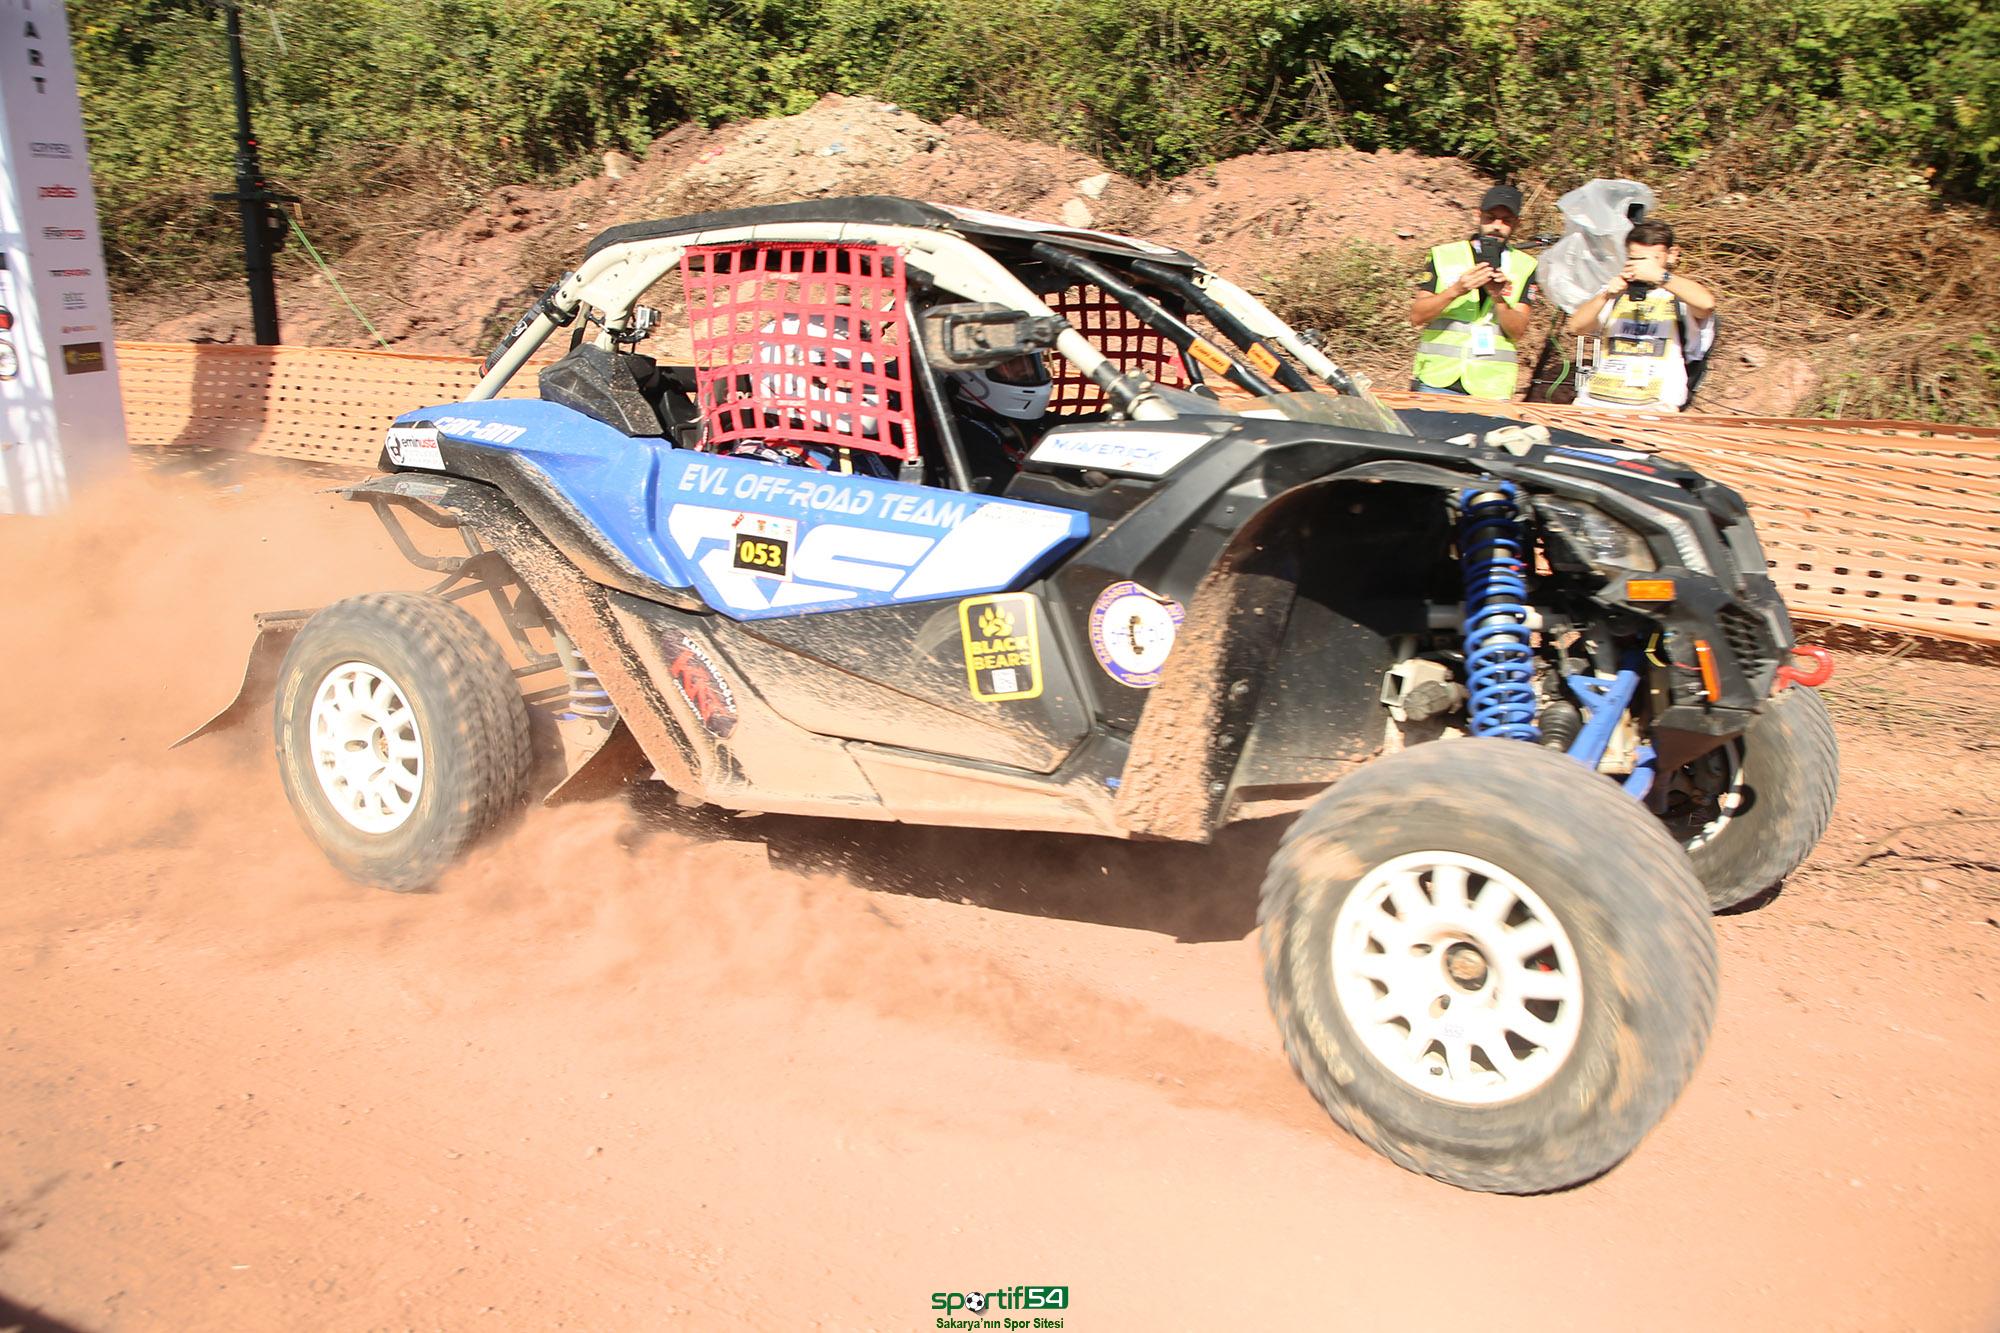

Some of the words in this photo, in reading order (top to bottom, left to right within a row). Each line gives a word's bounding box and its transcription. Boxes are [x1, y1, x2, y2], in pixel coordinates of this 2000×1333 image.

[433, 416, 528, 445] can-am
[678, 463, 730, 495] EVL
[734, 474, 875, 516] OFF-ROAD
[878, 493, 968, 529] TEAM
[740, 541, 782, 568] 053
[971, 636, 1029, 655] BLACK
[973, 651, 1032, 671] BEARS
